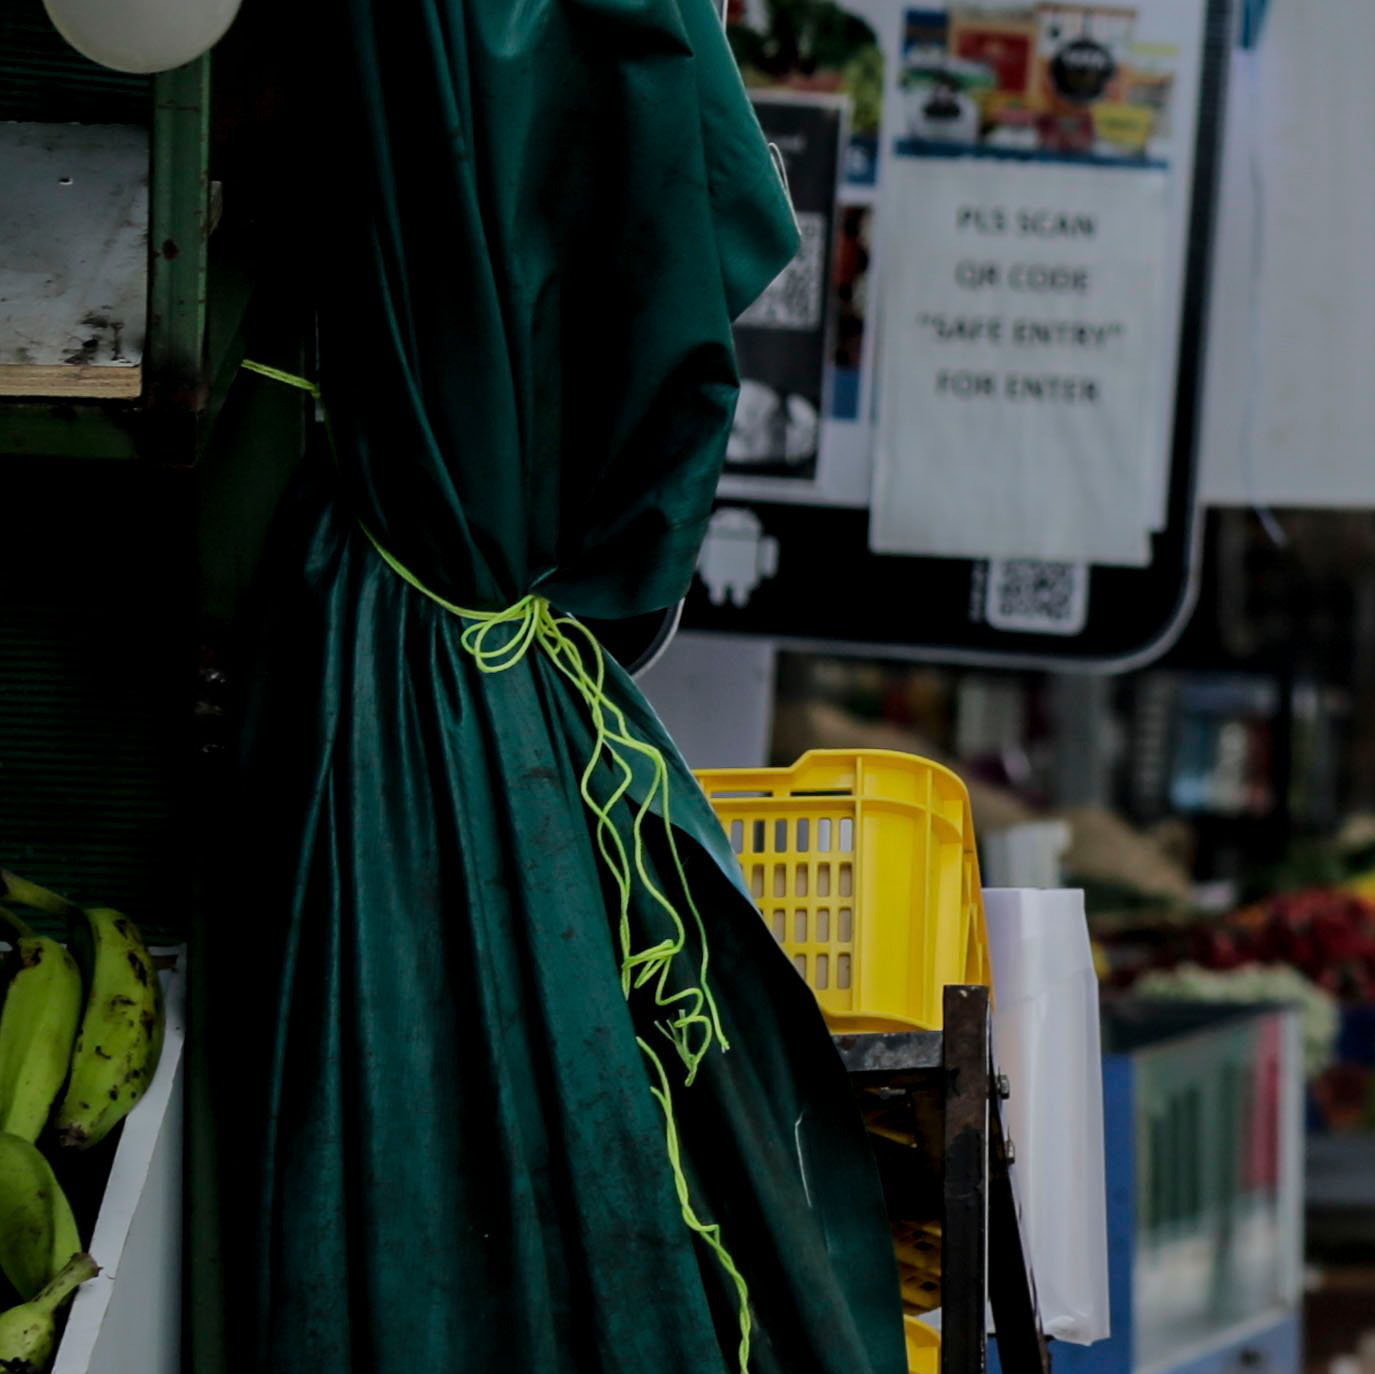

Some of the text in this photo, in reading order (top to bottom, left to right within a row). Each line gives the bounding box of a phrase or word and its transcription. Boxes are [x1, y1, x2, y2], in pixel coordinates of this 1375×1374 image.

[957, 206, 1095, 236] PLS SCAN
[955, 260, 1088, 291] QR CODE
[937, 370, 1099, 400] FOR ENTER
